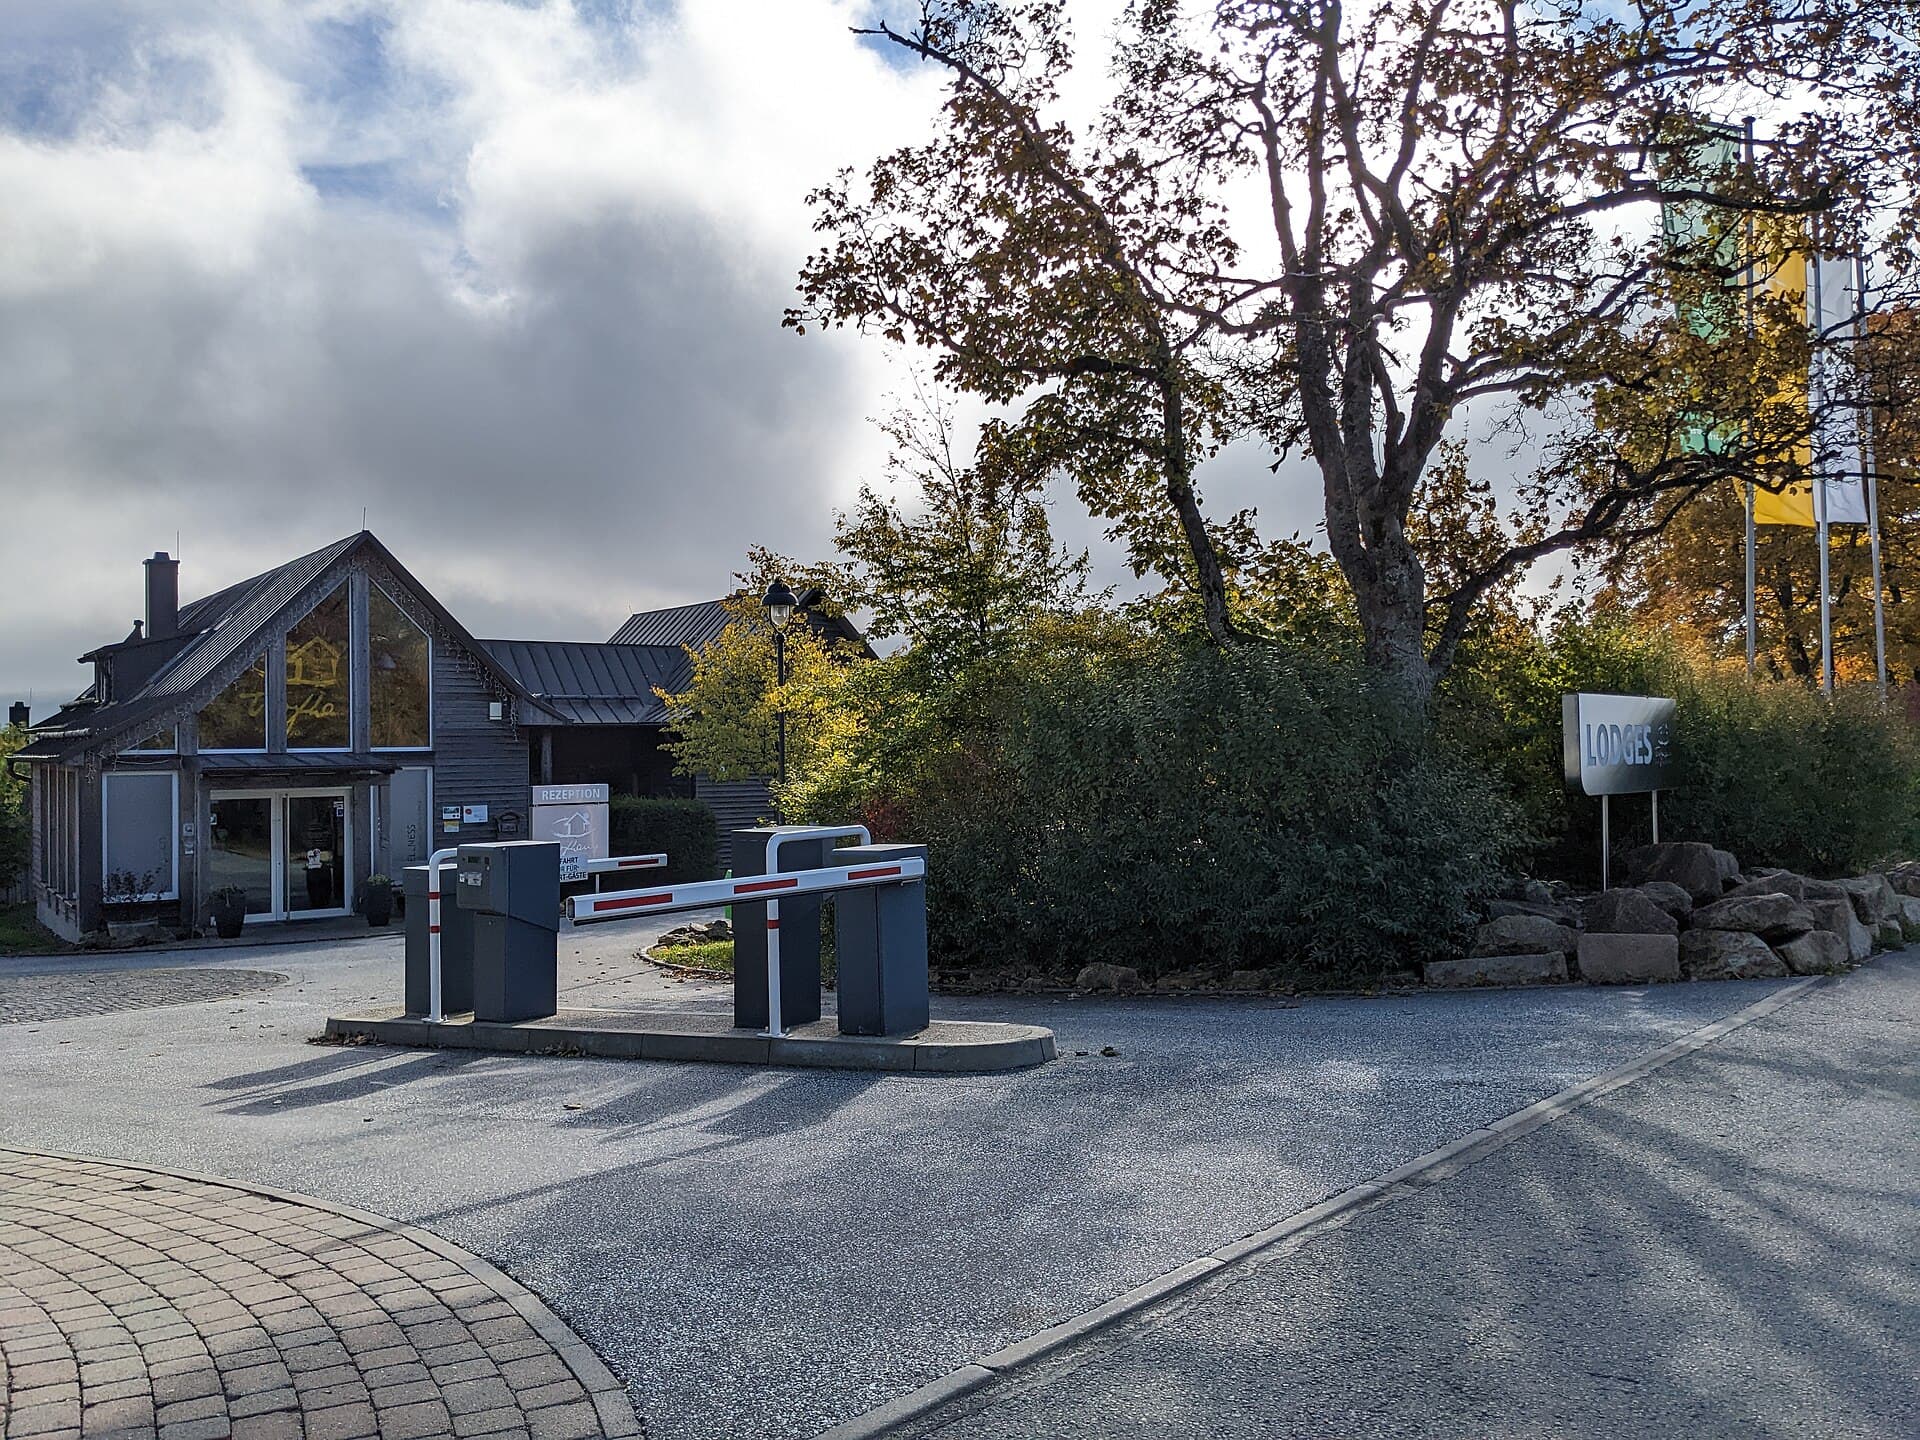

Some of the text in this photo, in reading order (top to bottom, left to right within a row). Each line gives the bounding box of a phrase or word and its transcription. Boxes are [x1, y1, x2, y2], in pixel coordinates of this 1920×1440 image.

[1586, 723, 1653, 766] LODGES
[542, 788, 600, 801] REZEPTION
[407, 823, 416, 862] ELLNESS
[560, 856, 577, 864] FAHRT
[560, 871, 587, 881] RT-GÄSTE
